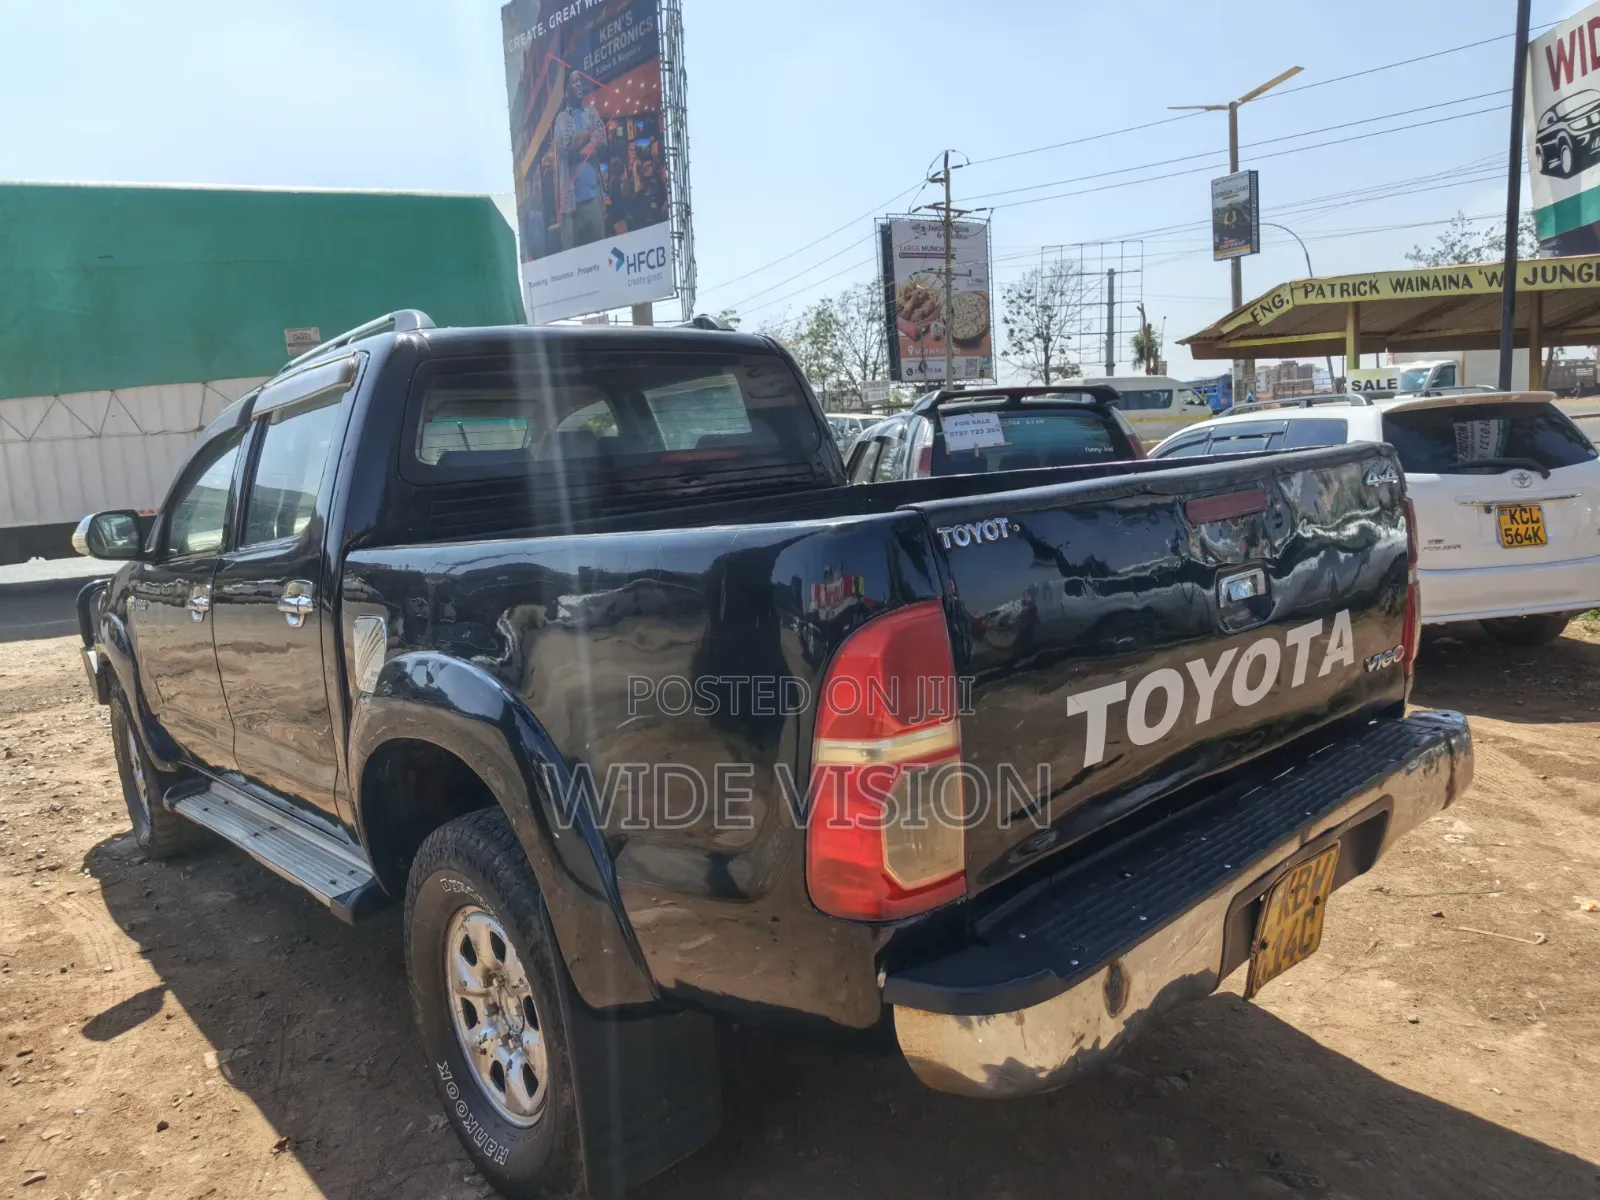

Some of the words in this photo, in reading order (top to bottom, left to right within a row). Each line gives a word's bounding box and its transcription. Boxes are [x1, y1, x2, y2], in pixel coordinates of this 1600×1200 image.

[508, 23, 547, 53] CREATE.
[549, 1, 581, 29] GREAT
[600, 10, 633, 43] KEN'S
[583, 16, 653, 71] ELECTRONICS
[626, 246, 666, 275] HFCB
[1250, 293, 1290, 323] ENG.
[1303, 277, 1380, 299] PATRICK
[1389, 273, 1473, 294] WAINAINA
[1351, 378, 1398, 391] SALE
[1509, 507, 1540, 525] KCL
[1504, 526, 1543, 545] 564K
[1067, 609, 1355, 768] TOYOTA
